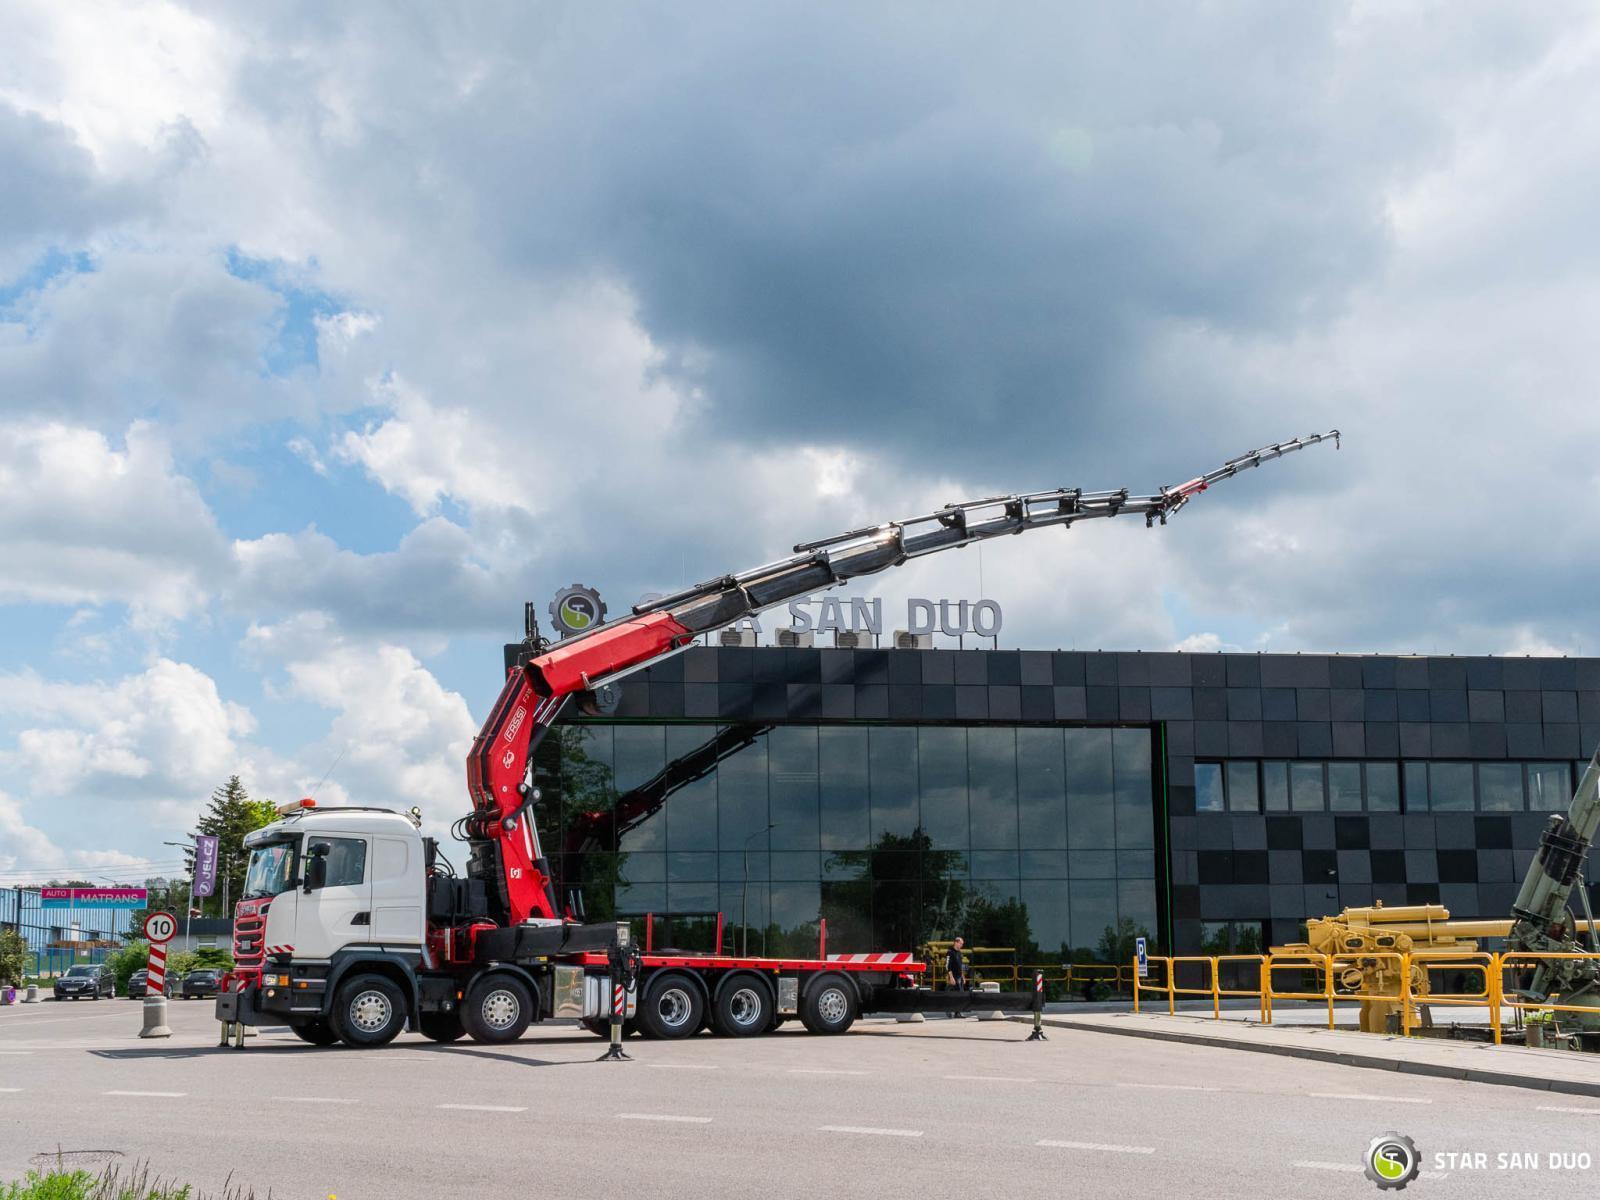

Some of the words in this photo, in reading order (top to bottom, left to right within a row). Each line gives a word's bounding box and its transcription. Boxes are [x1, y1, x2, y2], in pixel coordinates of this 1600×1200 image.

[788, 597, 882, 635] SAN
[907, 598, 1002, 637] DUO
[505, 707, 526, 740] FASSI
[201, 840, 214, 879] JELCZ
[80, 893, 139, 903] MATRANS
[152, 920, 171, 936] 10
[1139, 943, 1144, 961] P
